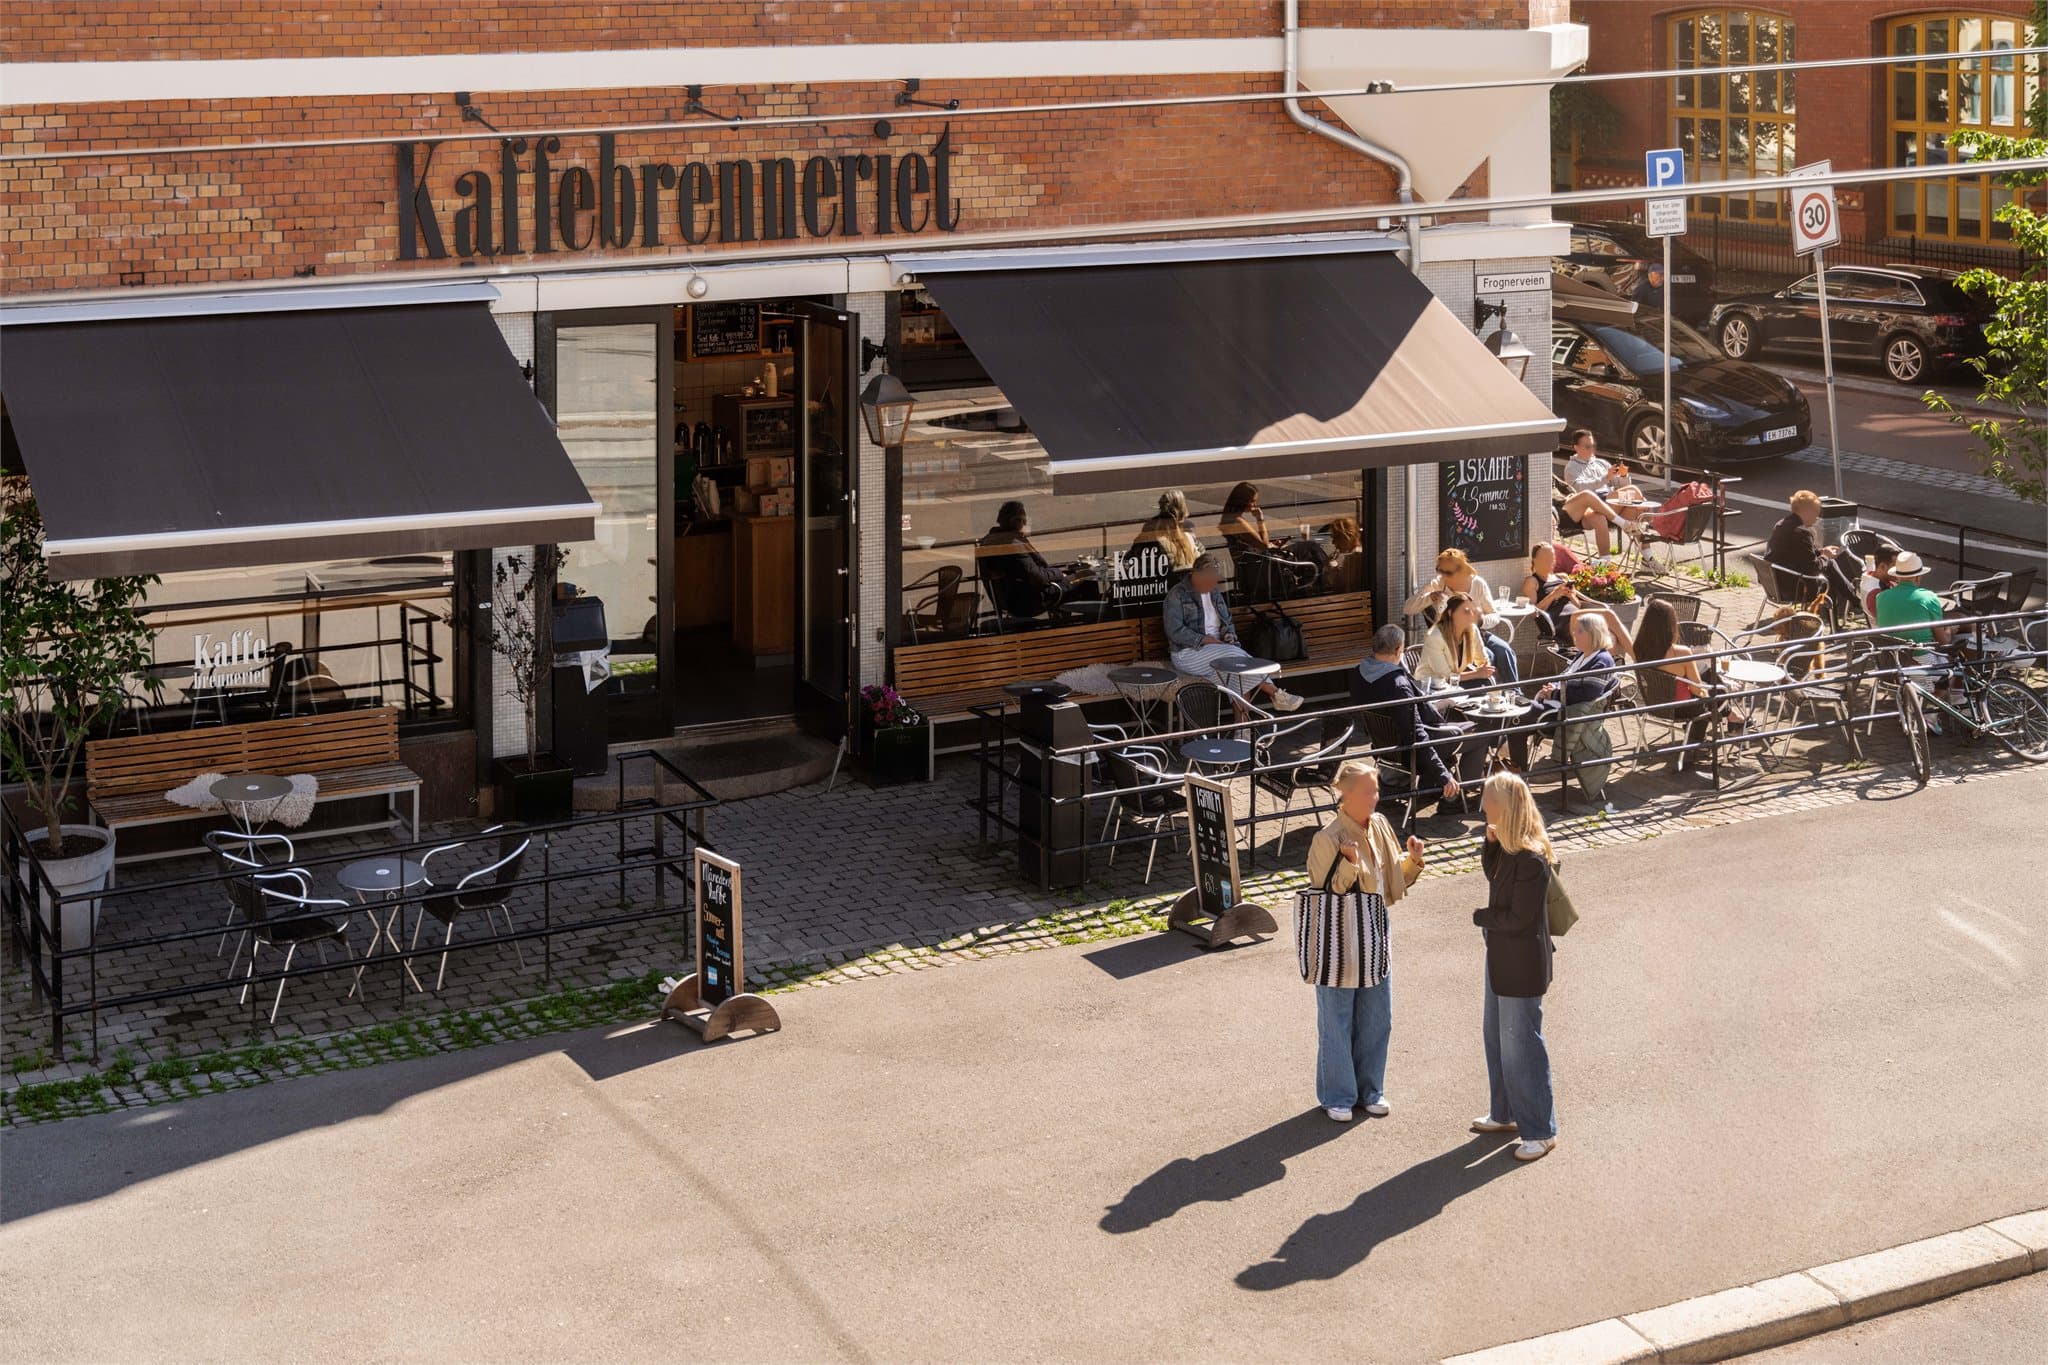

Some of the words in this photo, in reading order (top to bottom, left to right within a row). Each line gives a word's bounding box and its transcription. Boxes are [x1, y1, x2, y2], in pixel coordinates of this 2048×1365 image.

[1656, 157, 1675, 190] P
[396, 120, 961, 261] Kaffebrenneriet
[1805, 204, 1825, 229] 30
[1483, 275, 1545, 290] Frognerveien
[1456, 455, 1514, 487] ISKAFFE
[1467, 486, 1509, 515] Sommer
[1114, 547, 1169, 580] Kaffe
[1113, 580, 1168, 599] brenneriet
[194, 630, 267, 670] Kaffe
[194, 667, 266, 690] brenneriet
